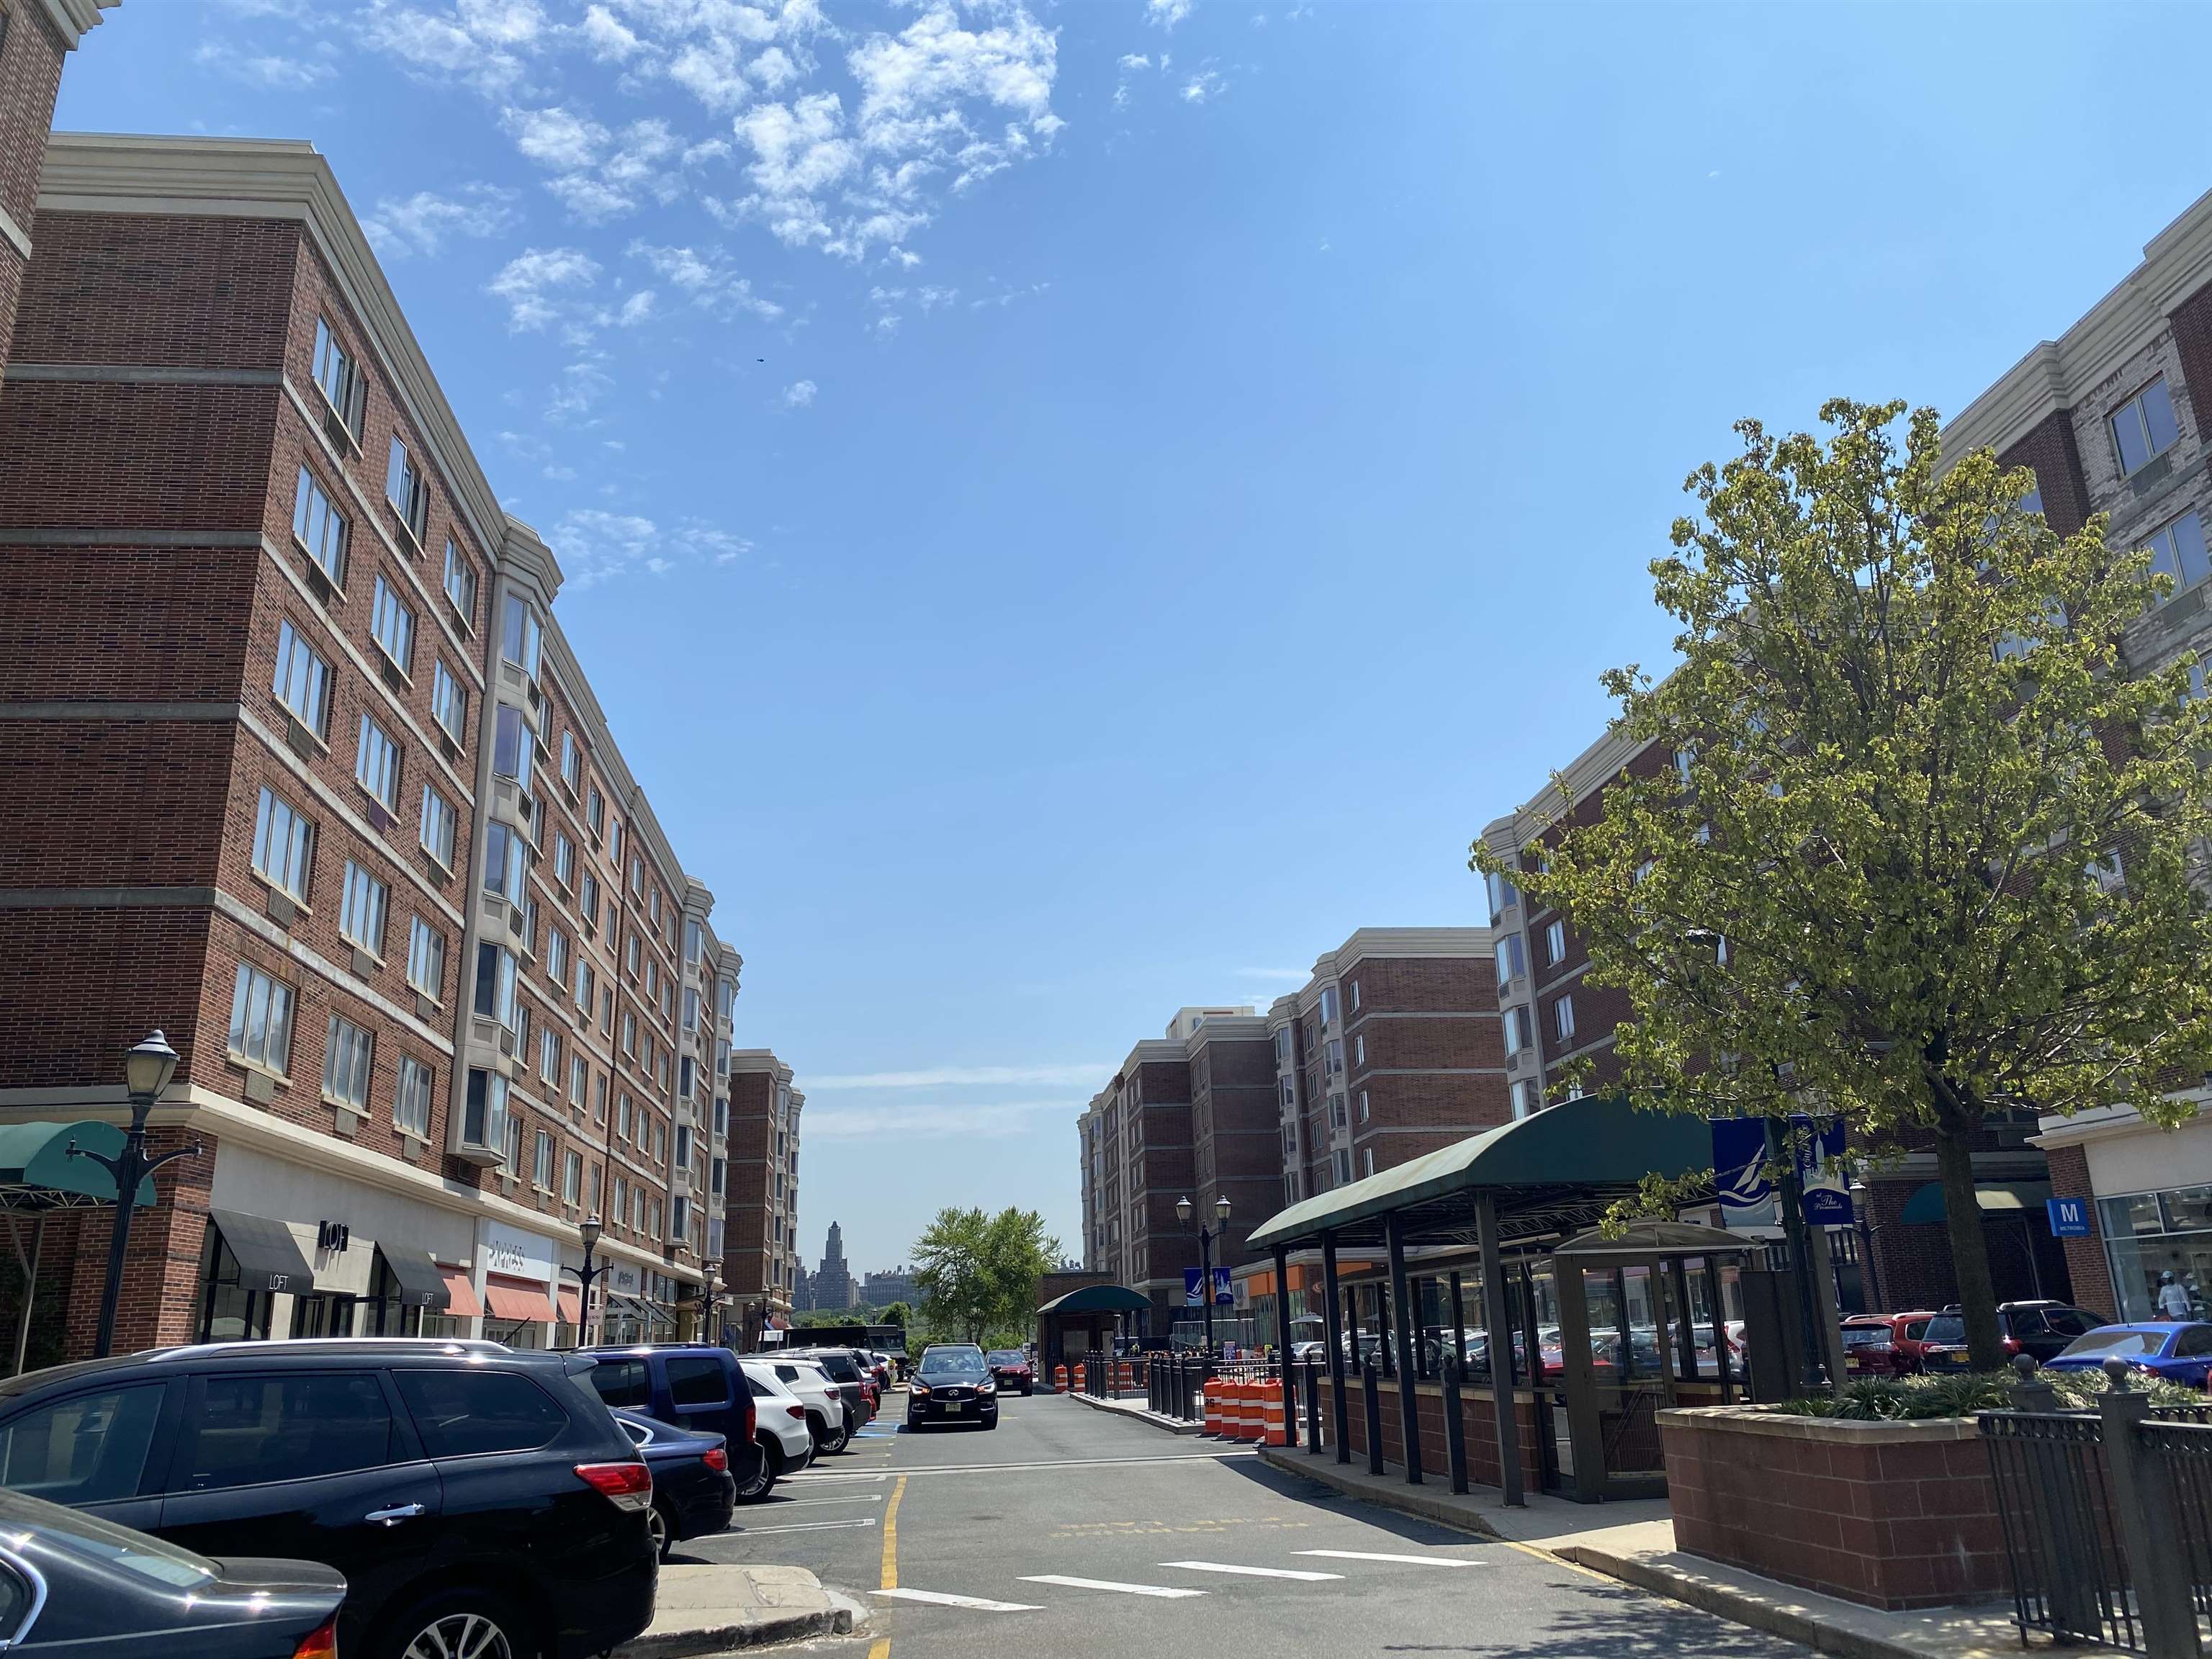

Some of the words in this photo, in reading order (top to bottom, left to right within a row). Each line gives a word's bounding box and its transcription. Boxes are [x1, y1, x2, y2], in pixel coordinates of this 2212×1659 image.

[1802, 1124, 1811, 1150] Pce
[1821, 1195, 1837, 1206] The
[2060, 1204, 2079, 1222] M
[269, 1274, 289, 1290] LOFT
[422, 1292, 433, 1305] LOFT
